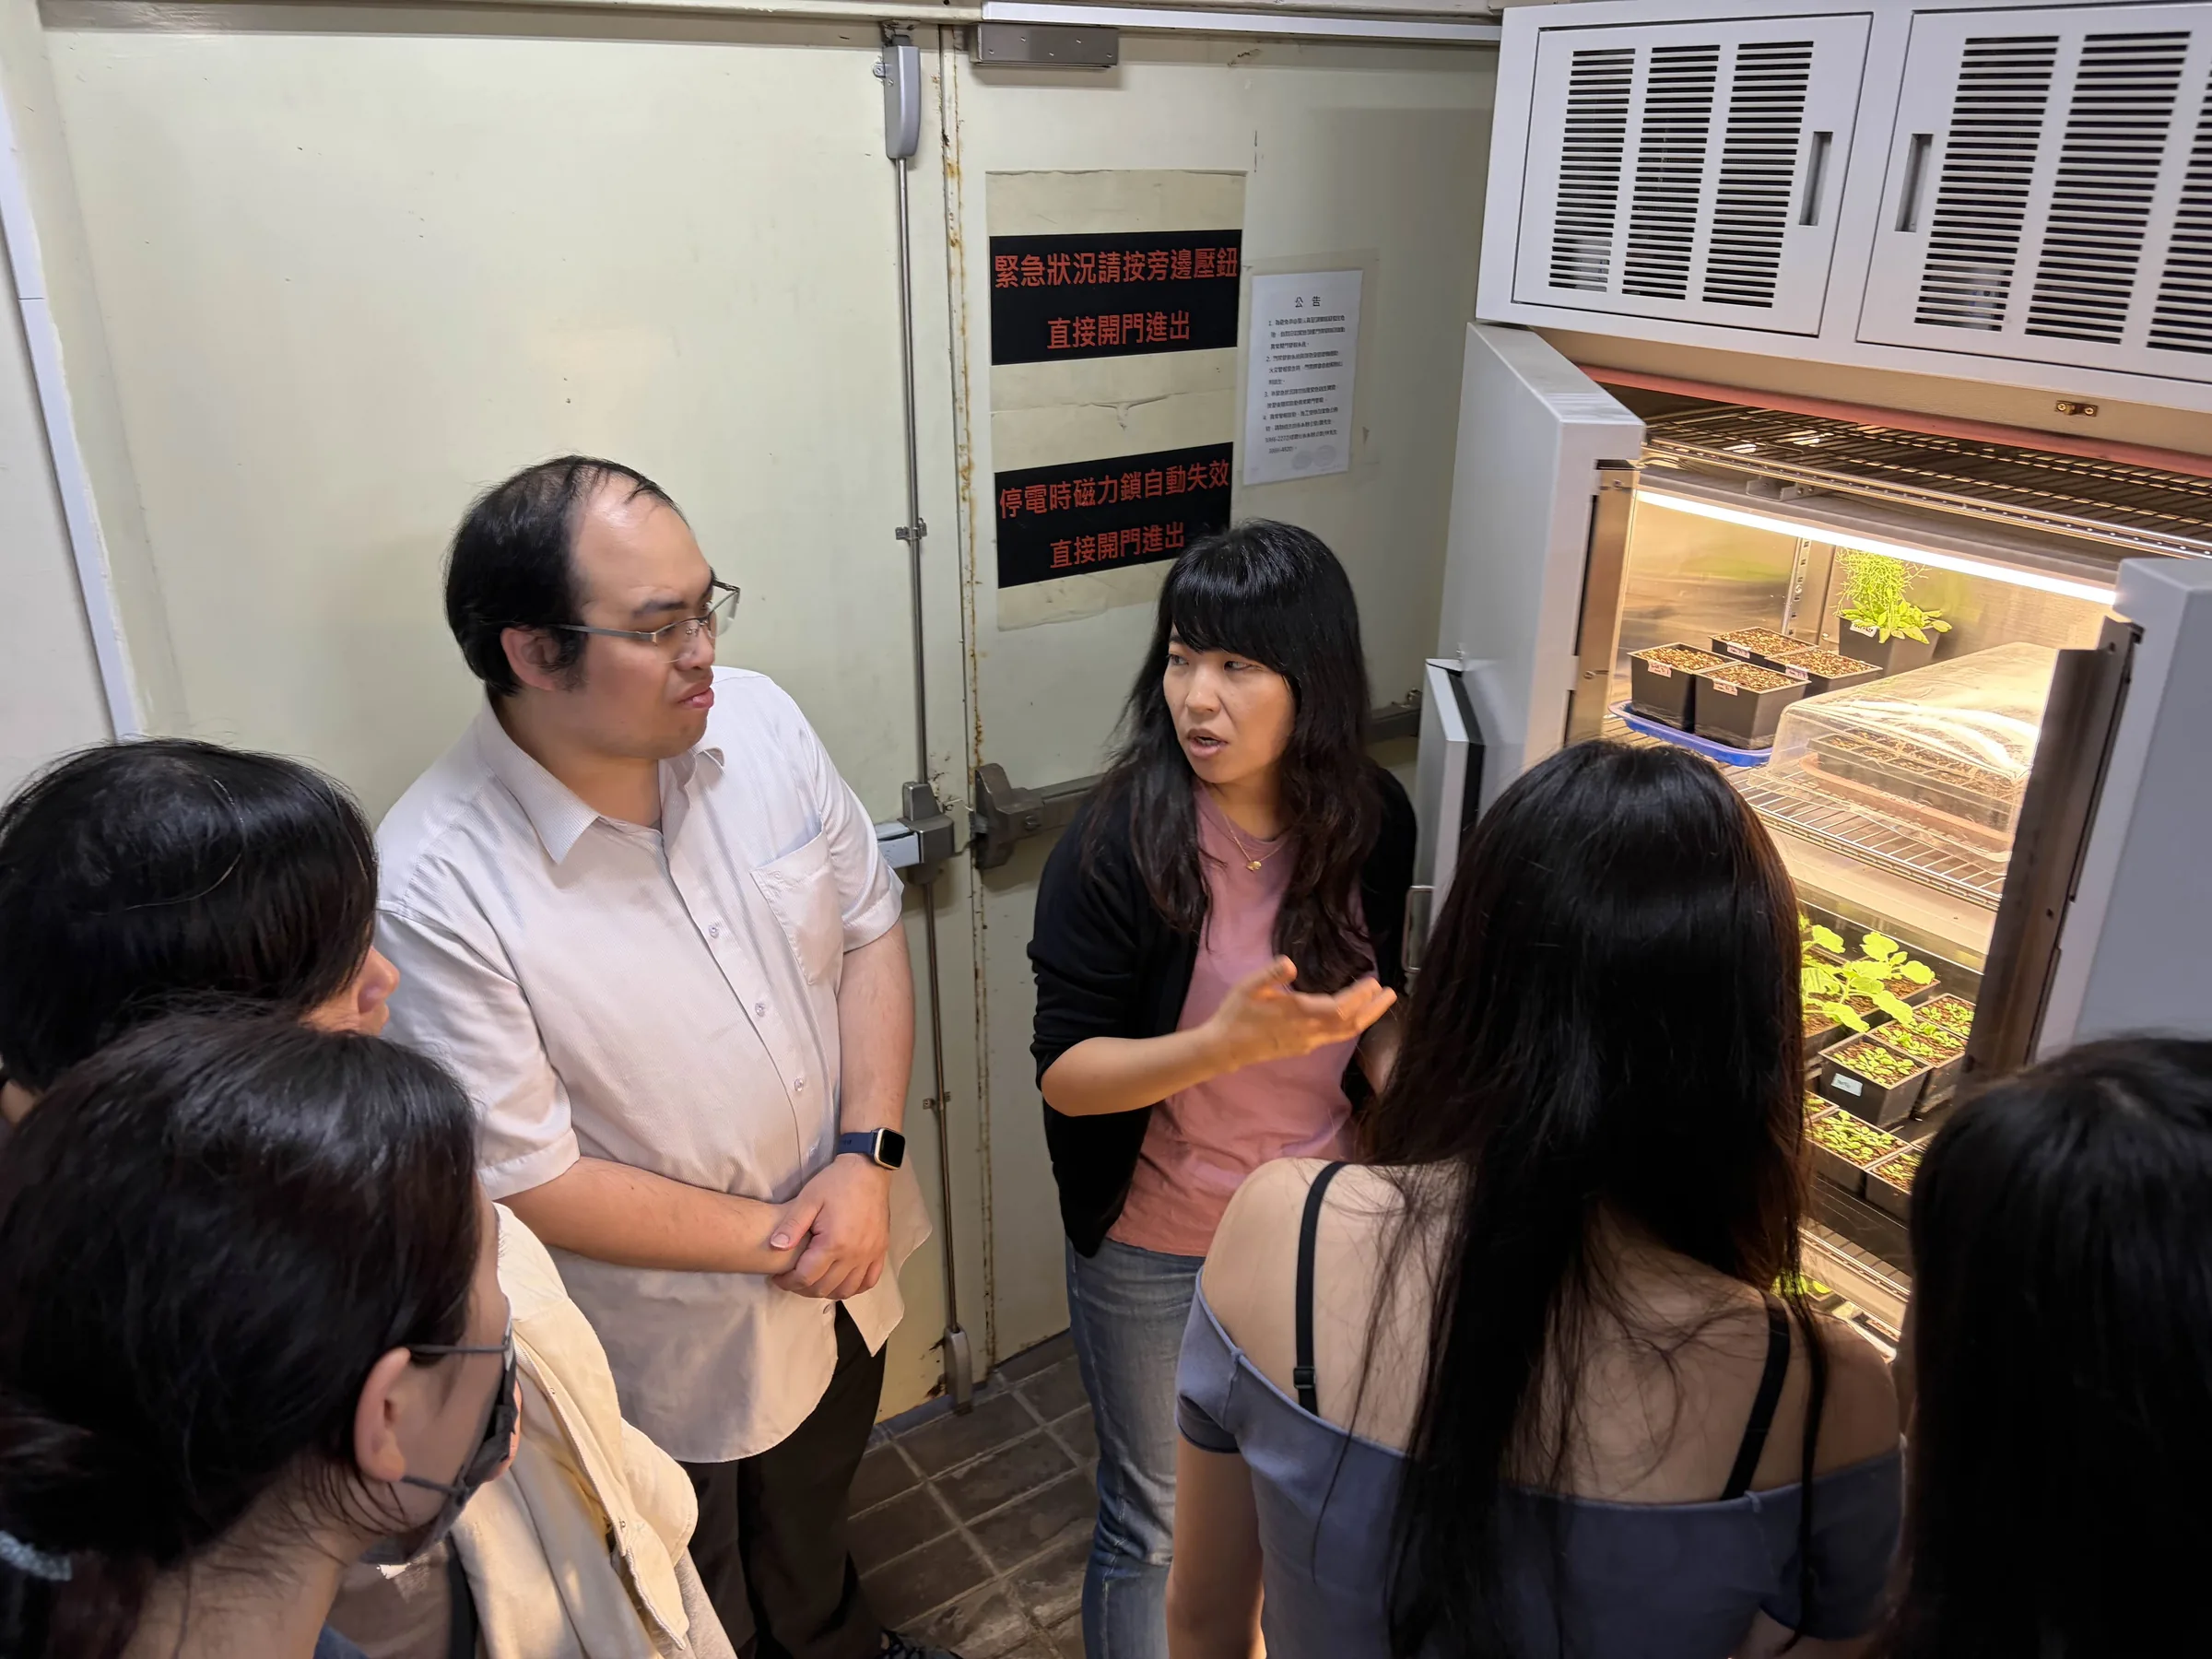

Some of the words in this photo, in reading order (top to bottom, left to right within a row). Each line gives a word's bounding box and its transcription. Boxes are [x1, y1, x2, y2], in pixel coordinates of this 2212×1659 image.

[994, 248, 1237, 288] 緊急狀況請按旁邊壓鈕
[1047, 310, 1190, 349] 直接開門進出
[999, 460, 1229, 518] 停電時磁力鎖自動失效
[1050, 524, 1184, 569] 直接開門進出
